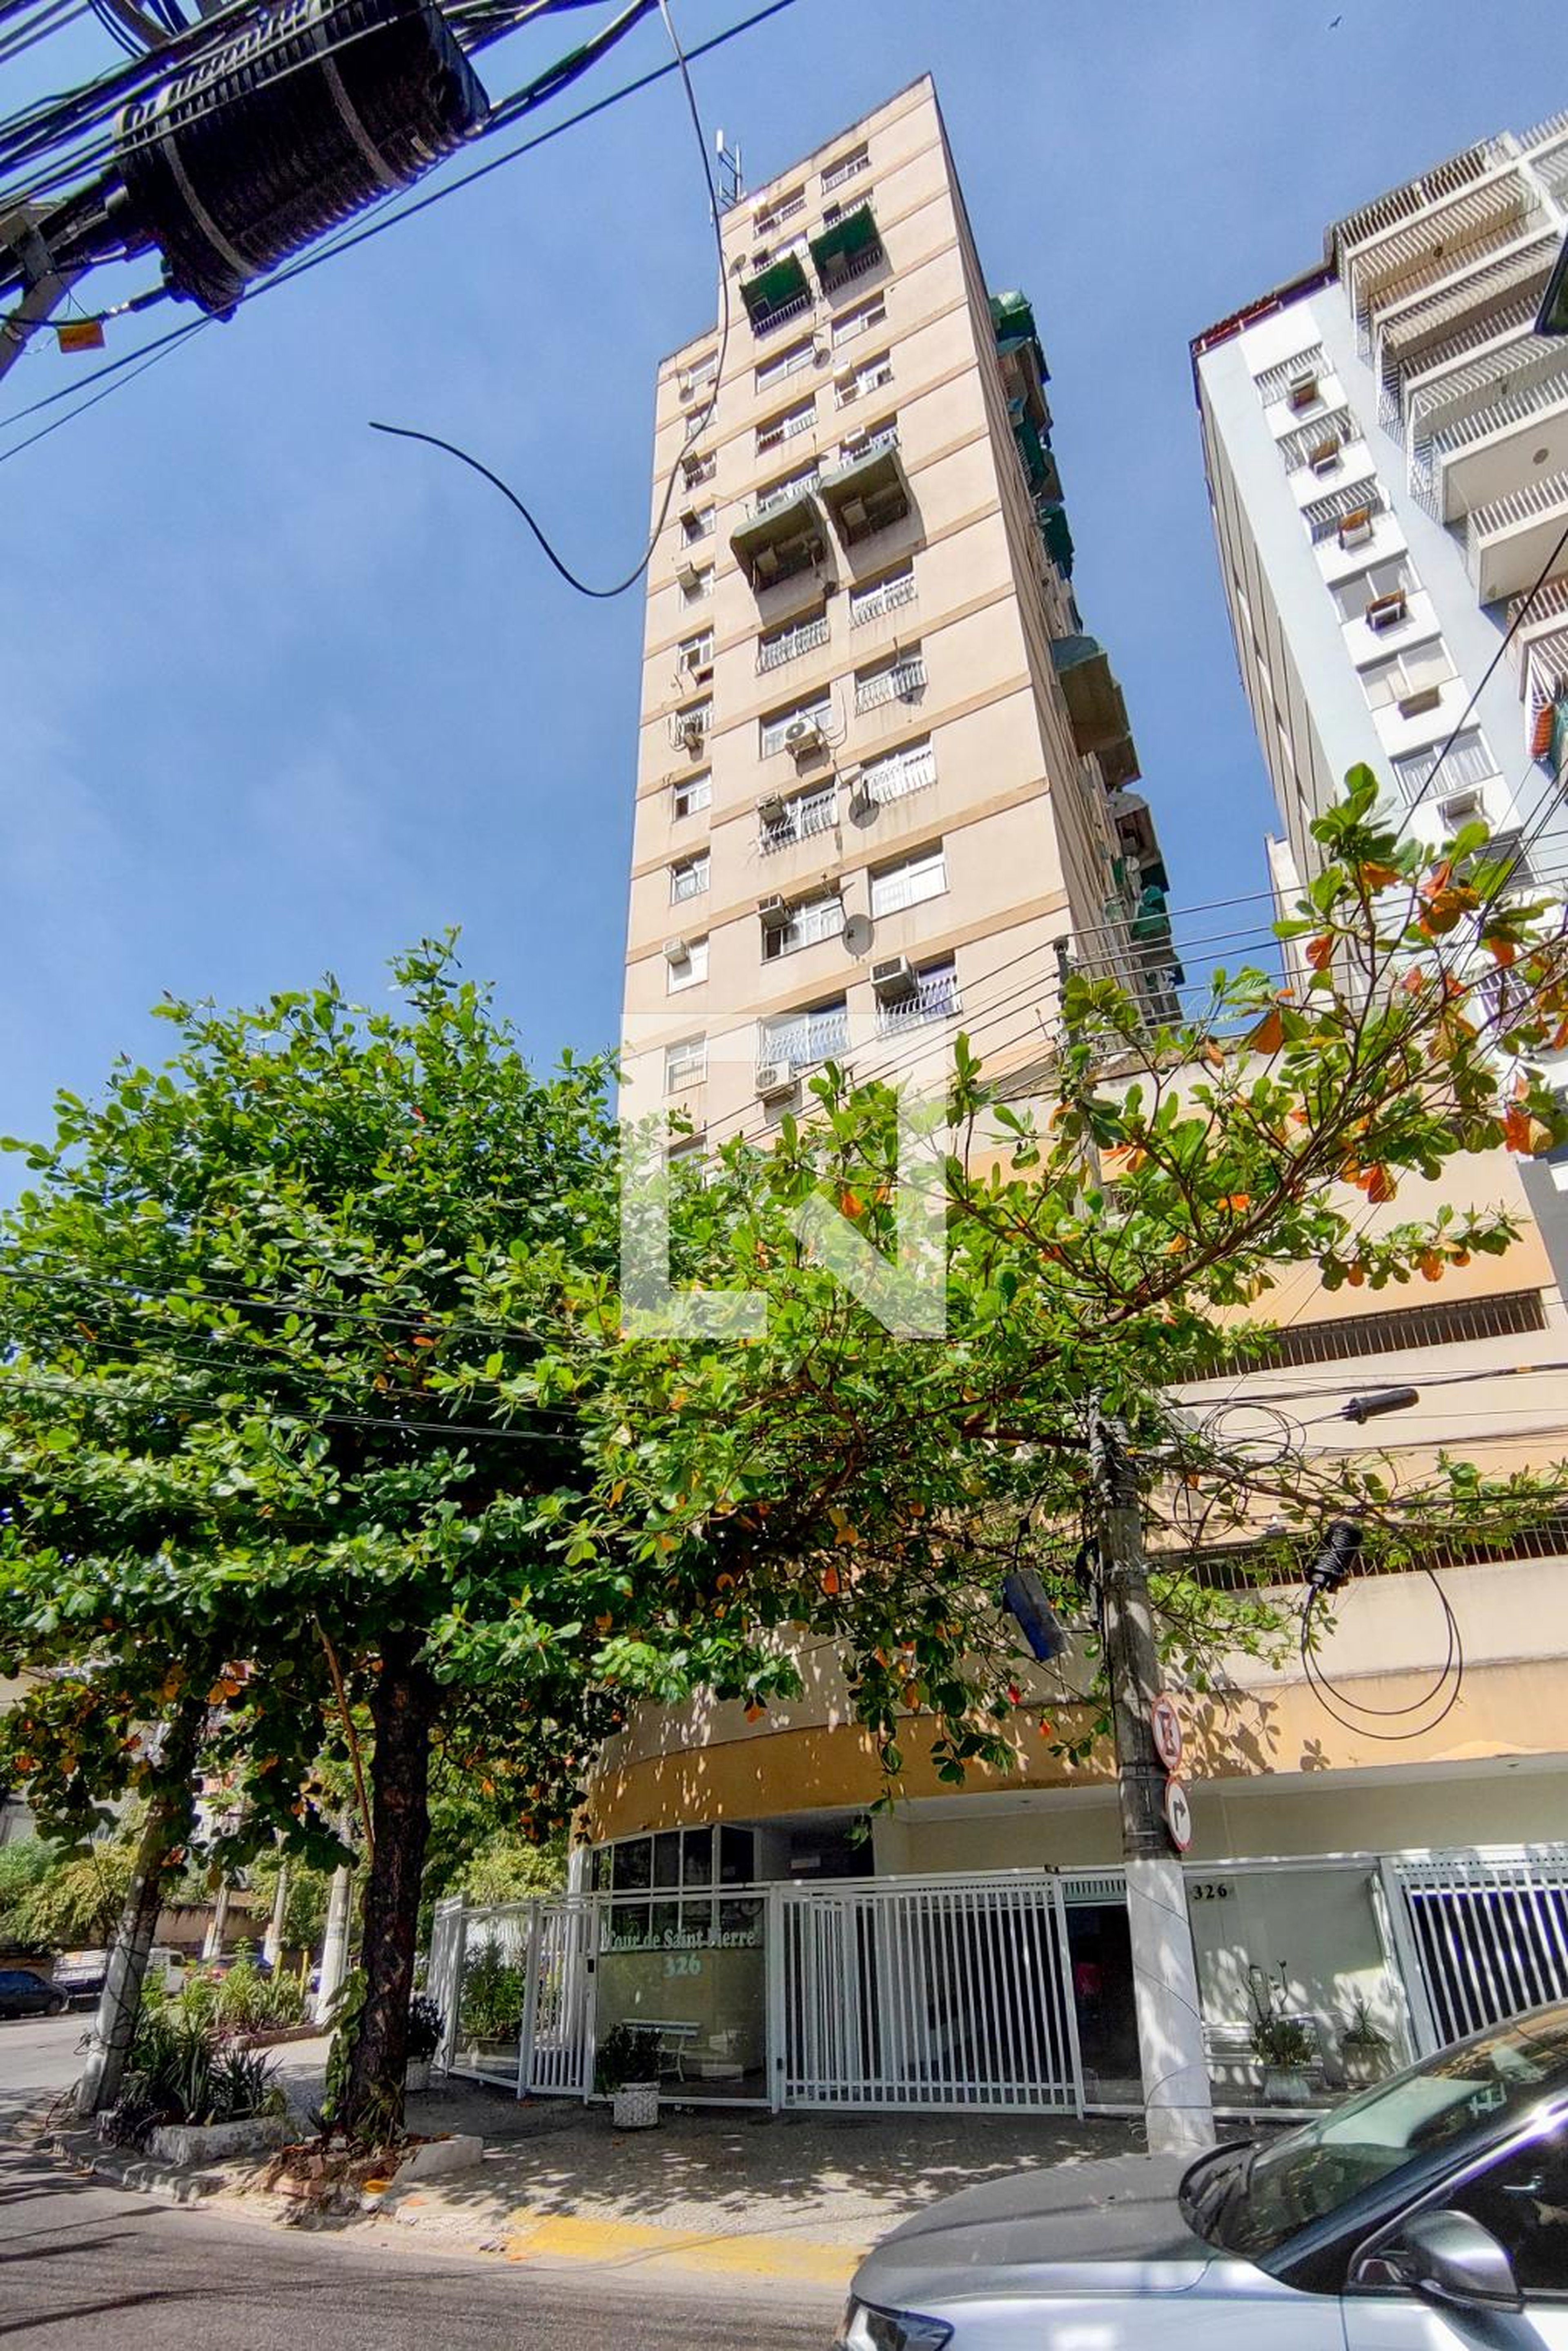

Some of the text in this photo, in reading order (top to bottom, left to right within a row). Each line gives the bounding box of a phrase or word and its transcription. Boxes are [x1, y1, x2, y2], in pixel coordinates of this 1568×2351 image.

[1192, 1883, 1227, 1900] 326
[642, 1929, 661, 1950] de
[663, 1928, 703, 1949] Saint
[663, 1953, 701, 1977] 326
